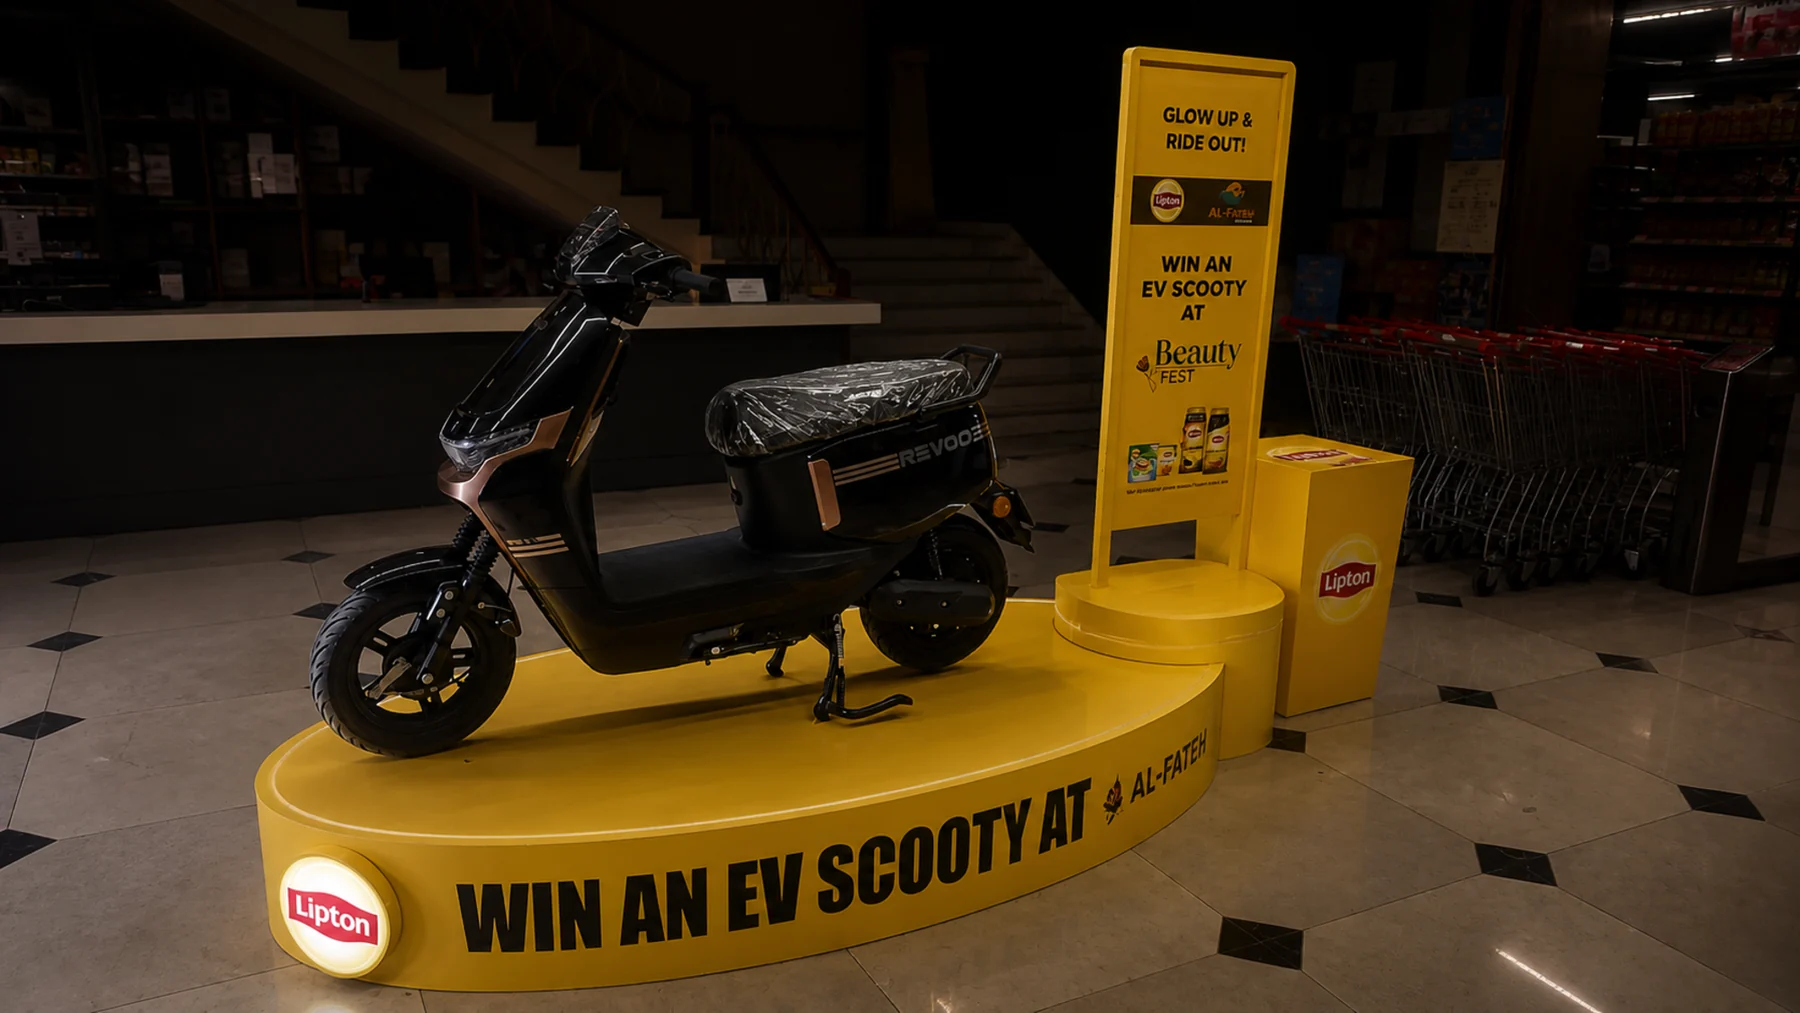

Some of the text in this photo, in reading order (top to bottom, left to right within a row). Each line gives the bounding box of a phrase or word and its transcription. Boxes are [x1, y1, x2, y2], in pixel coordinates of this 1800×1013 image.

[1163, 106, 1253, 128] GLOW UP &
[1166, 133, 1247, 153] RIDE OUT!
[1155, 194, 1181, 207] Lipton
[1161, 255, 1232, 273] WIN AN
[1141, 279, 1247, 298] EV SCOOTY
[1181, 304, 1205, 321] AT
[1155, 338, 1242, 370] Beauty
[1160, 368, 1196, 384] FEST
[1324, 570, 1371, 593] Lipton
[1129, 727, 1208, 805] AL-FATEH
[456, 776, 1093, 953] WIN AN EV SCOOTY AT
[295, 893, 371, 938] Lipton
